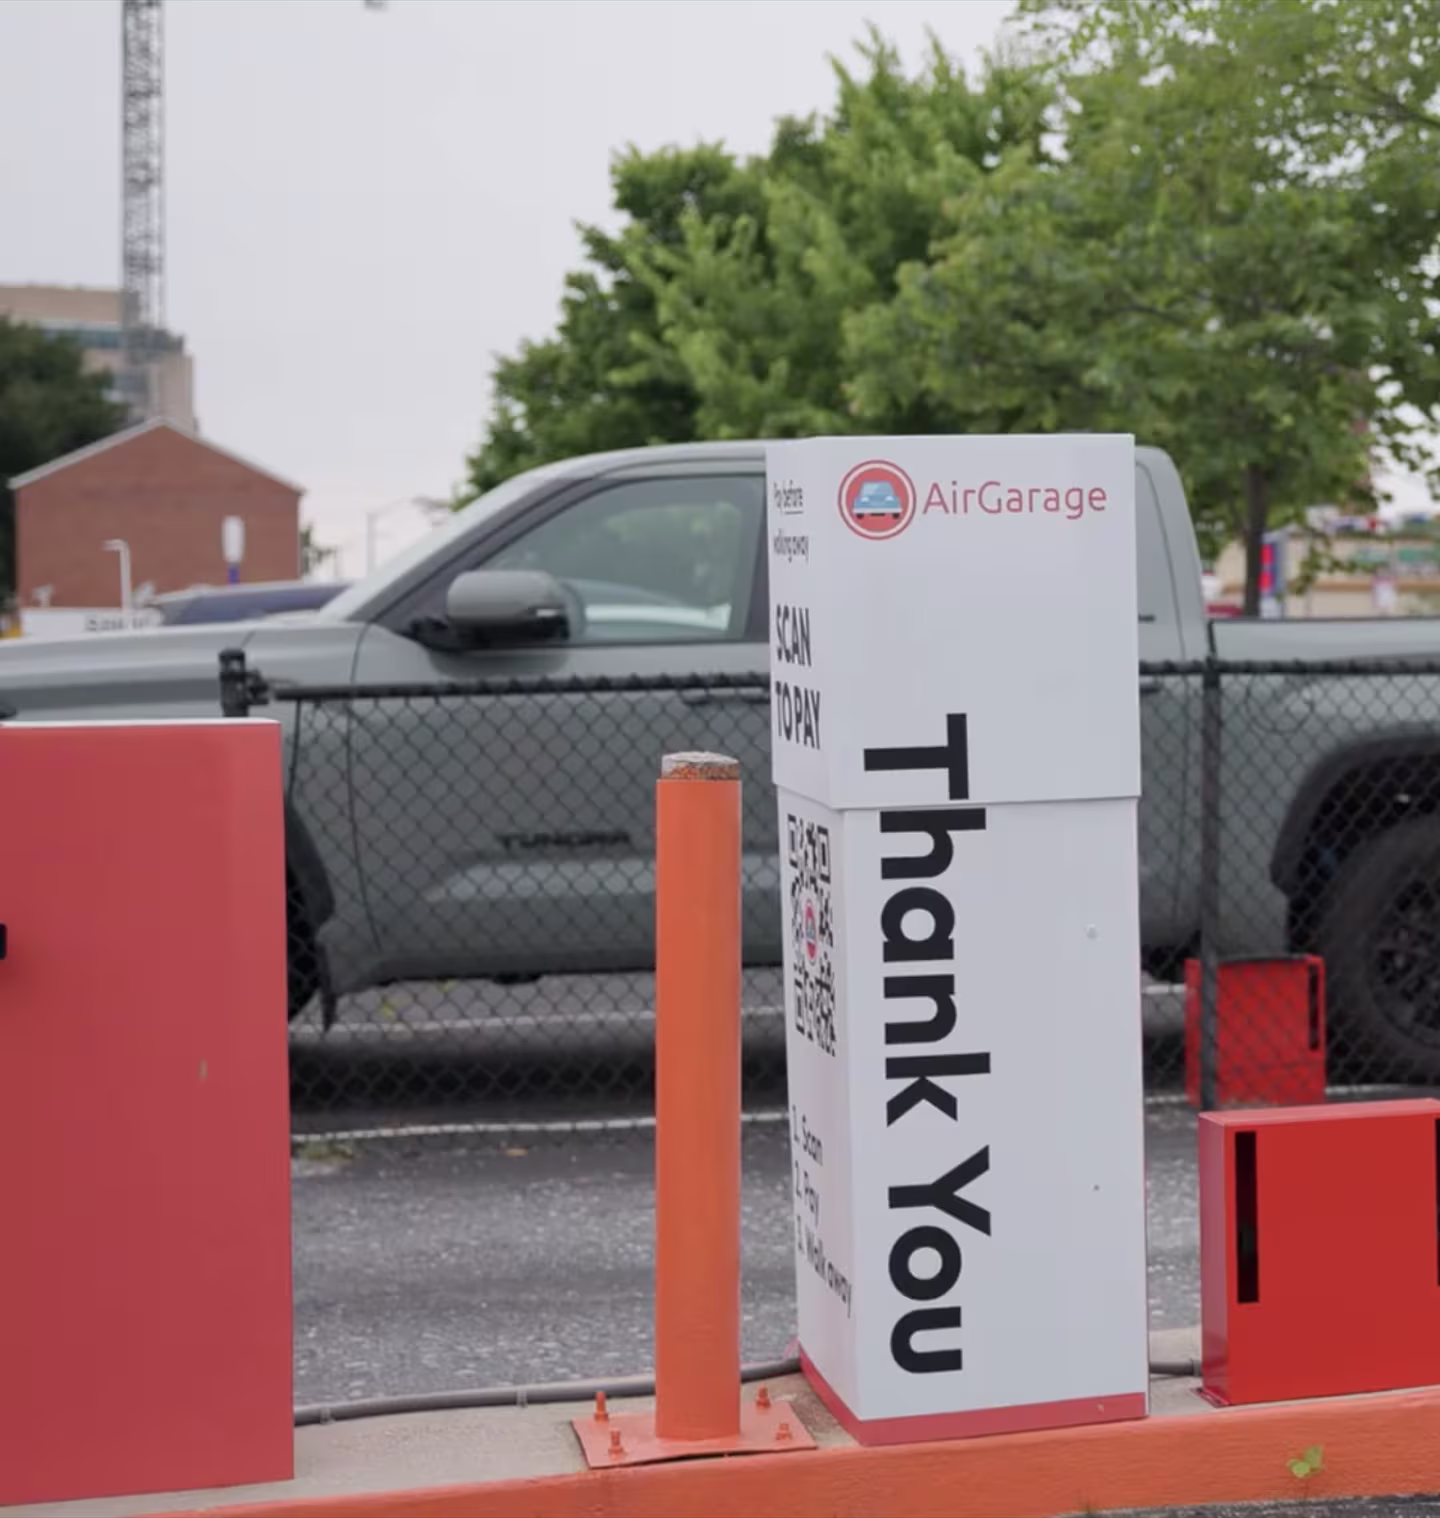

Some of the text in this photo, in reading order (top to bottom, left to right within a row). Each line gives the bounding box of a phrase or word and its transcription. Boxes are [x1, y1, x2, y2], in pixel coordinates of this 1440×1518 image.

[922, 481, 1107, 519] AirGarage
[776, 603, 811, 668] SCAN
[775, 680, 820, 751] TO PAY
[864, 713, 991, 1374] Thank You
[802, 1114, 823, 1167] Scan
[804, 1170, 820, 1227] Pay
[806, 1224, 827, 1281] Walk
[827, 1260, 852, 1319] away
